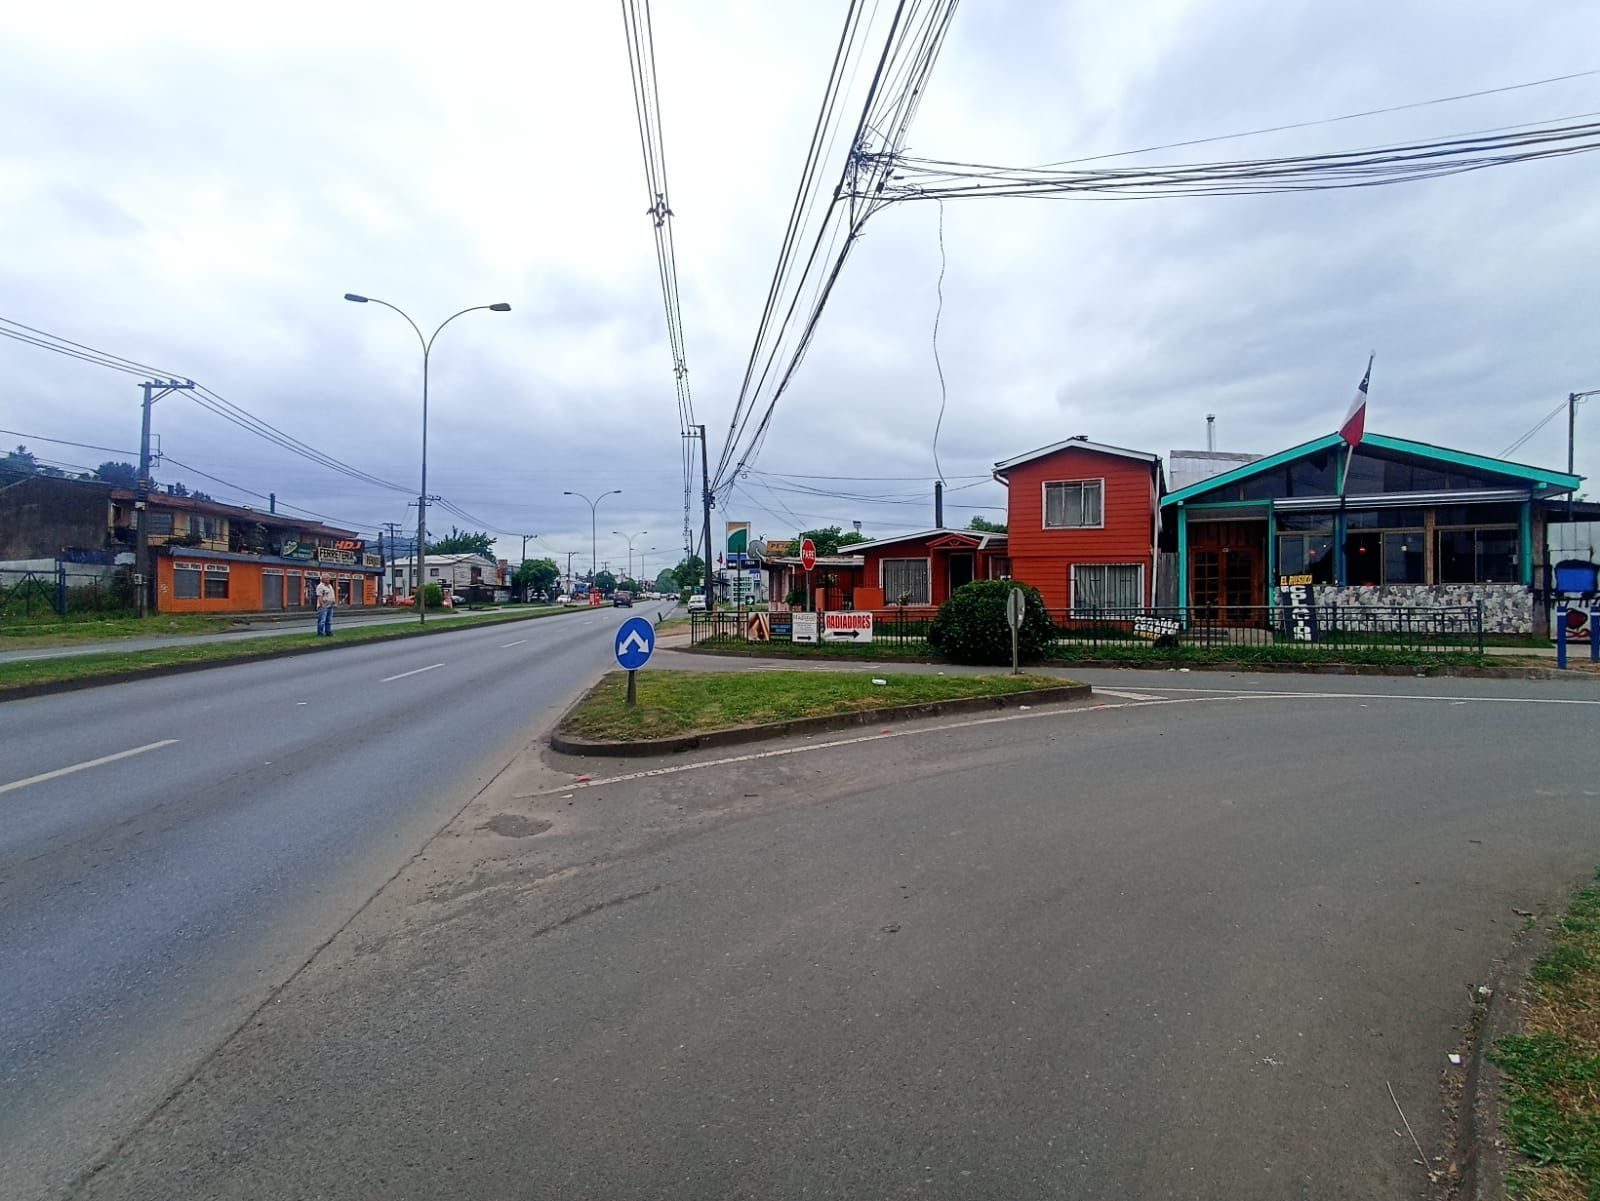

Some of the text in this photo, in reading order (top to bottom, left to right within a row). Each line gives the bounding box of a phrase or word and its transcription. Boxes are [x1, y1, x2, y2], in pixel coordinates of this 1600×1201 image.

[320, 549, 354, 560] FERRETERIA
[802, 550, 815, 559] PARE
[1280, 576, 1289, 586] EL
[826, 614, 871, 629] RADIADORES
